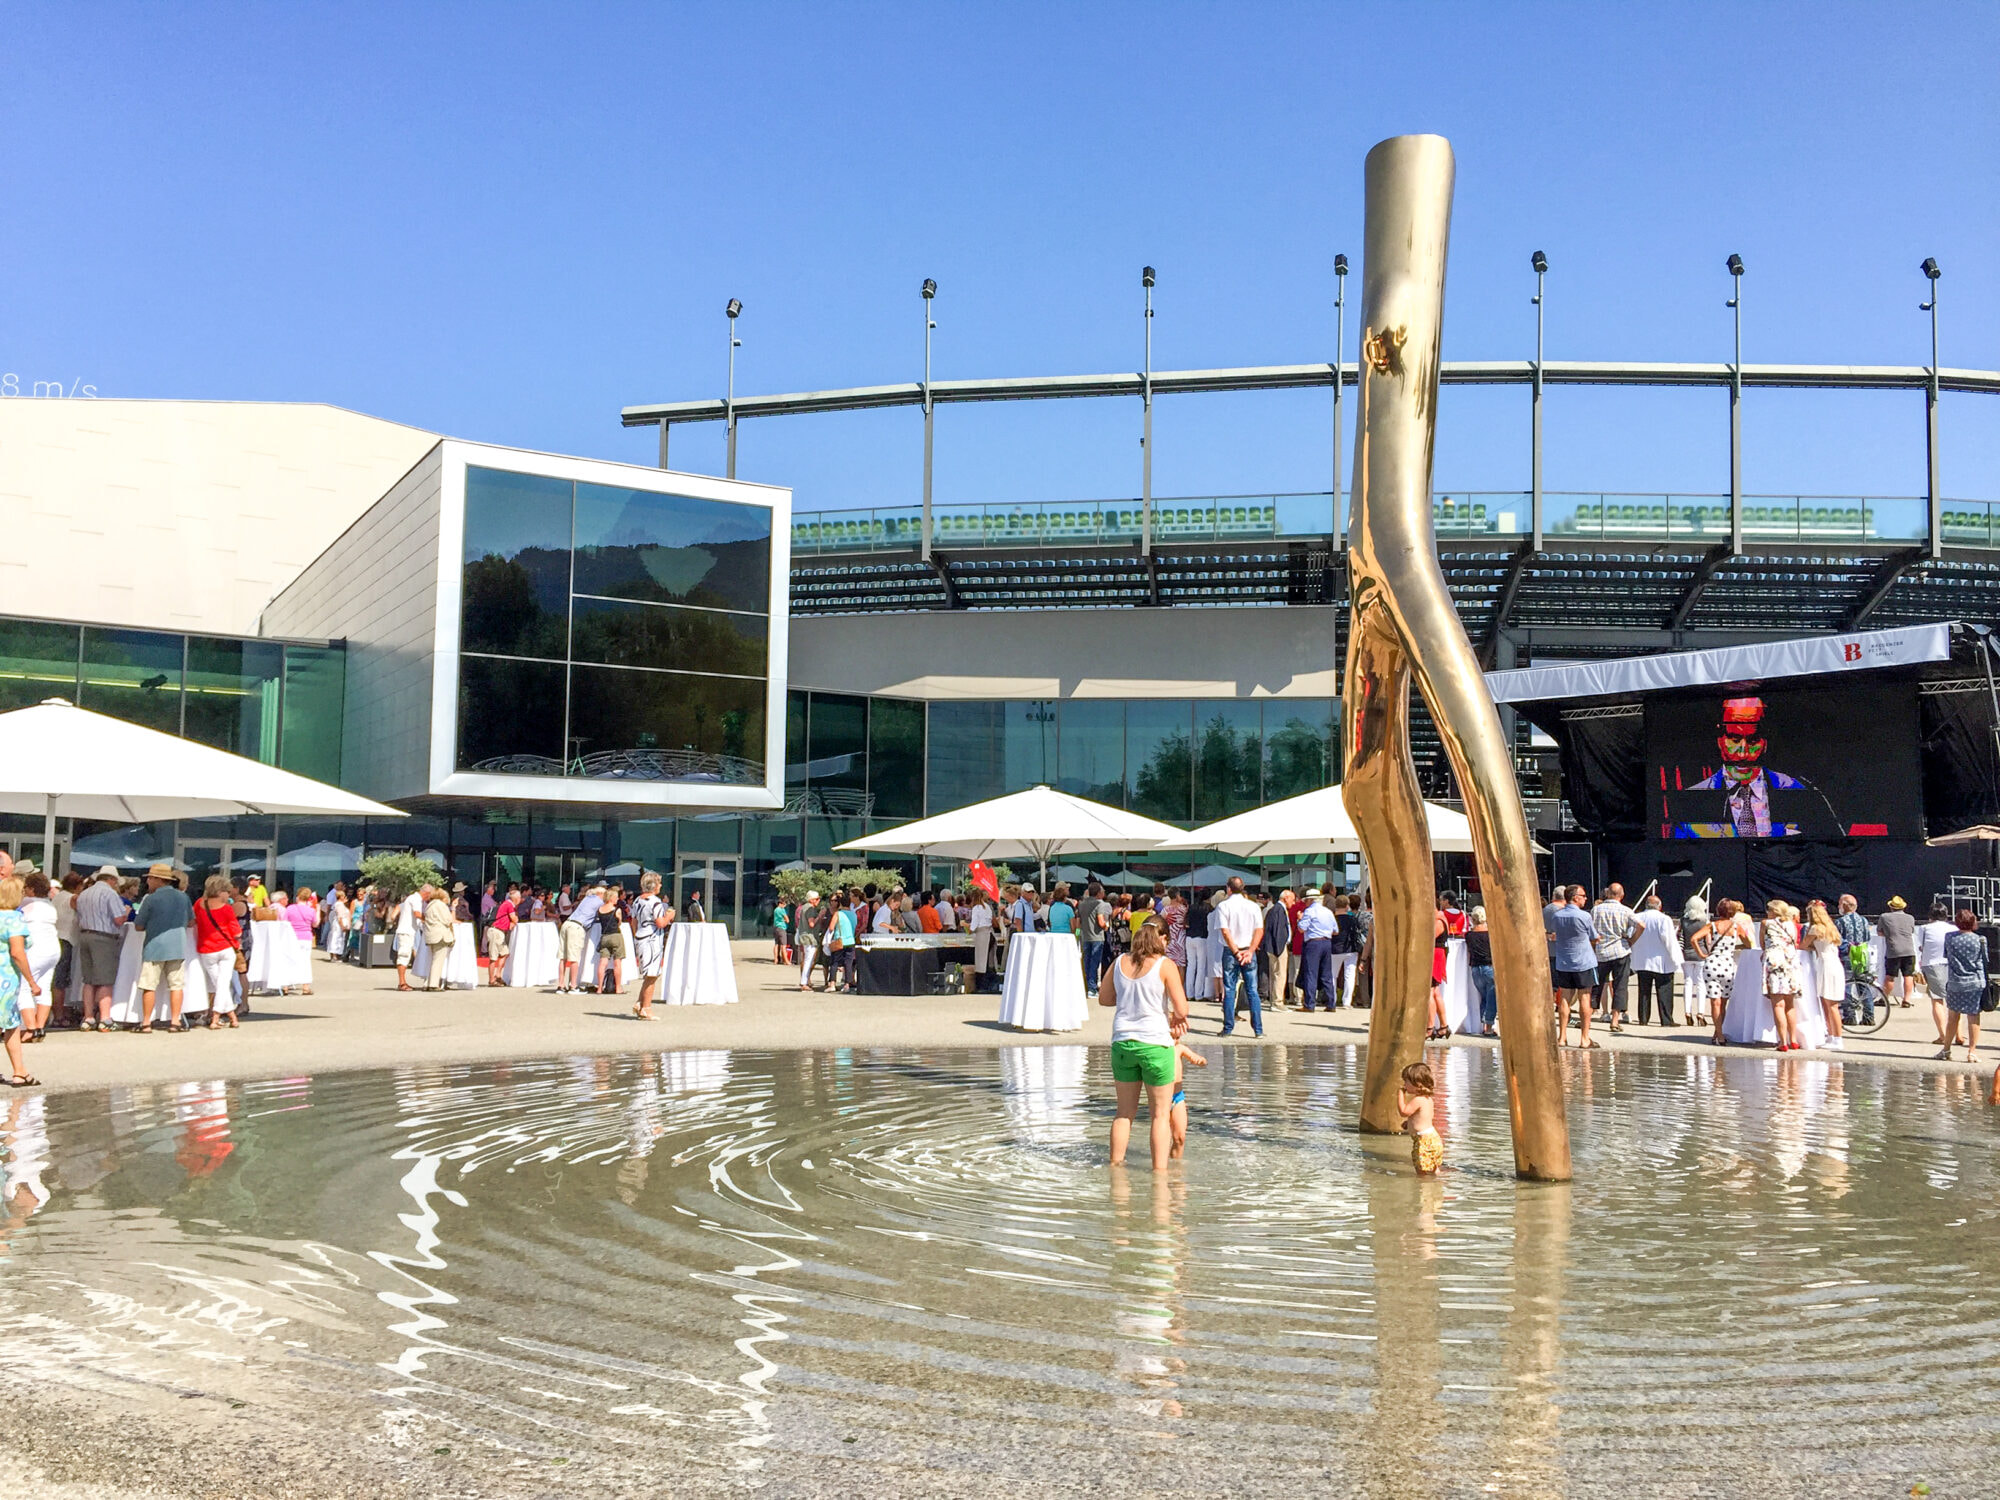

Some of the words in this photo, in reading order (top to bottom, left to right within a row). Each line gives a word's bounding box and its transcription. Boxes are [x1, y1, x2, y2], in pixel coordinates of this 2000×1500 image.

[1, 373, 19, 397] 8
[33, 377, 97, 398] m/s
[1844, 643, 1862, 661] B
